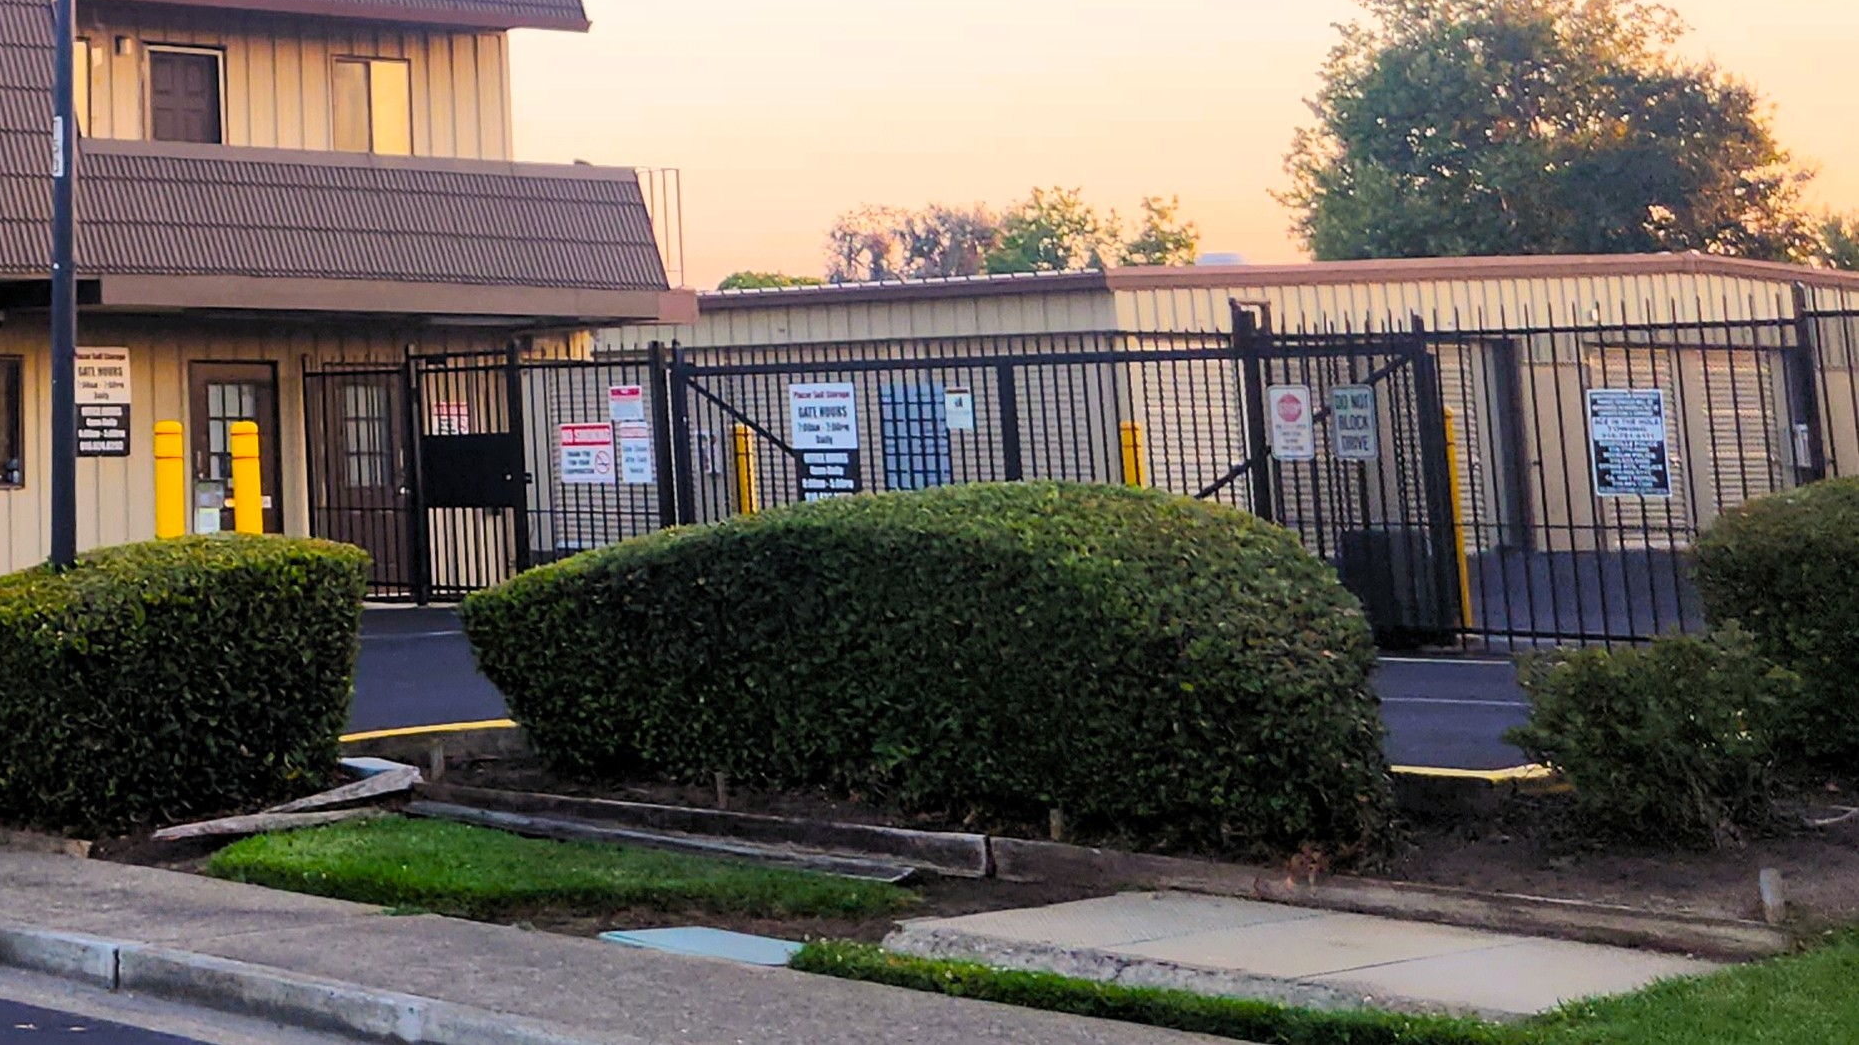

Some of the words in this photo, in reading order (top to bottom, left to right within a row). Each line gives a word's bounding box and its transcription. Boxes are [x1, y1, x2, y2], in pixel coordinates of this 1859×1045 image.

[1334, 394, 1348, 410] DO
[1351, 394, 1369, 409] NOT
[798, 406, 817, 418] GATE
[819, 406, 848, 417] HOURS
[1338, 414, 1369, 430] BLOCK
